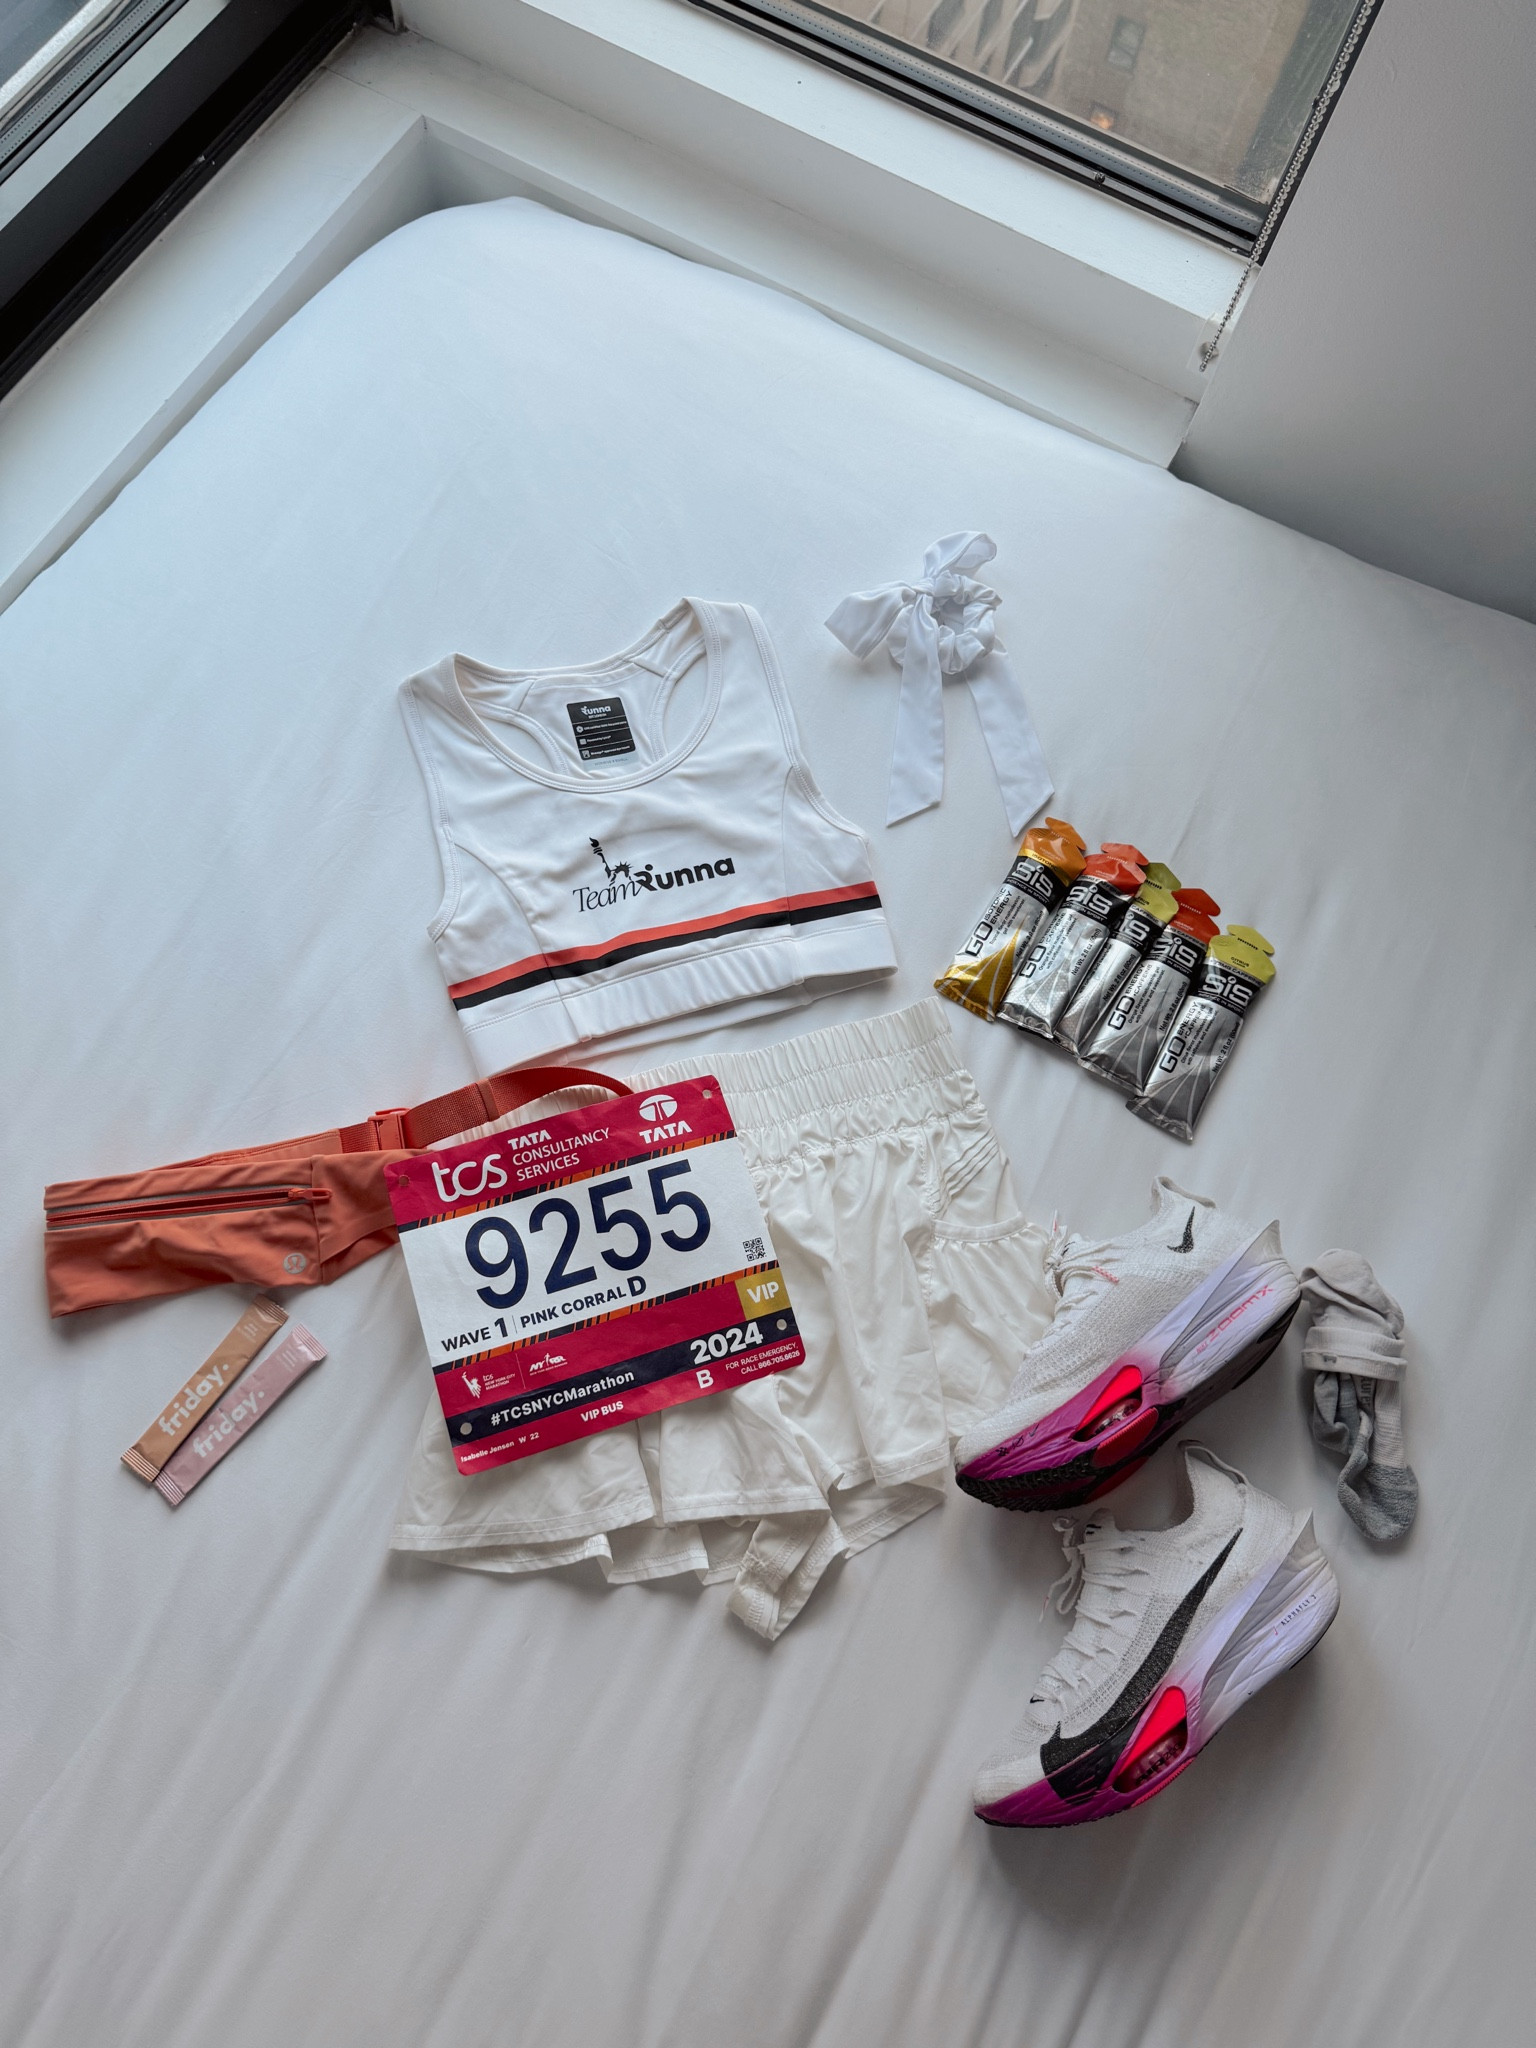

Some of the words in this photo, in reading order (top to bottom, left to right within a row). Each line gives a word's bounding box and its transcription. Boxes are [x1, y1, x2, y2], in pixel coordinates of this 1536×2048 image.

[581, 706, 611, 715] Runna
[1012, 862, 1053, 897] SiS
[991, 890, 1012, 924] ENERGY
[1066, 884, 1112, 915] SiS
[965, 921, 992, 956] GO
[1019, 946, 1046, 978] GO
[1070, 964, 1080, 975] Net
[1231, 956, 1249, 967] CITRUS
[1102, 990, 1112, 1002] Net
[1119, 968, 1126, 976] oz
[1126, 964, 1144, 995] ENERGY
[1147, 989, 1155, 998] and
[1202, 974, 1252, 1006] SiS
[1108, 996, 1135, 1030] GO
[1158, 1020, 1168, 1031] Net
[1177, 1002, 1198, 1035] ENERGY
[1159, 1036, 1186, 1073] GO
[1211, 1061, 1221, 1073] Net
[1225, 1037, 1233, 1045] oz
[508, 1129, 552, 1149] TATA
[512, 1127, 611, 1167] CONSULTANCY
[639, 1120, 692, 1144] TATA
[431, 1153, 508, 1203] tcs
[516, 1152, 581, 1182] SERVICES
[464, 1158, 711, 1310] 9255
[747, 1281, 780, 1304] VIP
[441, 1326, 492, 1353] WAVE
[493, 1317, 509, 1338] 1
[520, 1305, 559, 1329] PINK
[561, 1286, 627, 1316] CORRAL
[628, 1275, 647, 1298] D
[690, 1322, 764, 1365] 2024
[725, 1361, 739, 1370] FOR
[741, 1355, 758, 1365] RACE
[741, 1364, 758, 1375] CALL
[486, 1380, 509, 1390] MARATHON
[696, 1369, 714, 1389] B
[490, 1369, 635, 1427] #TCSNYCMarathon
[581, 1410, 600, 1422] VIP
[602, 1401, 624, 1416] BUS
[519, 1436, 527, 1444] W
[530, 1432, 540, 1440] 22
